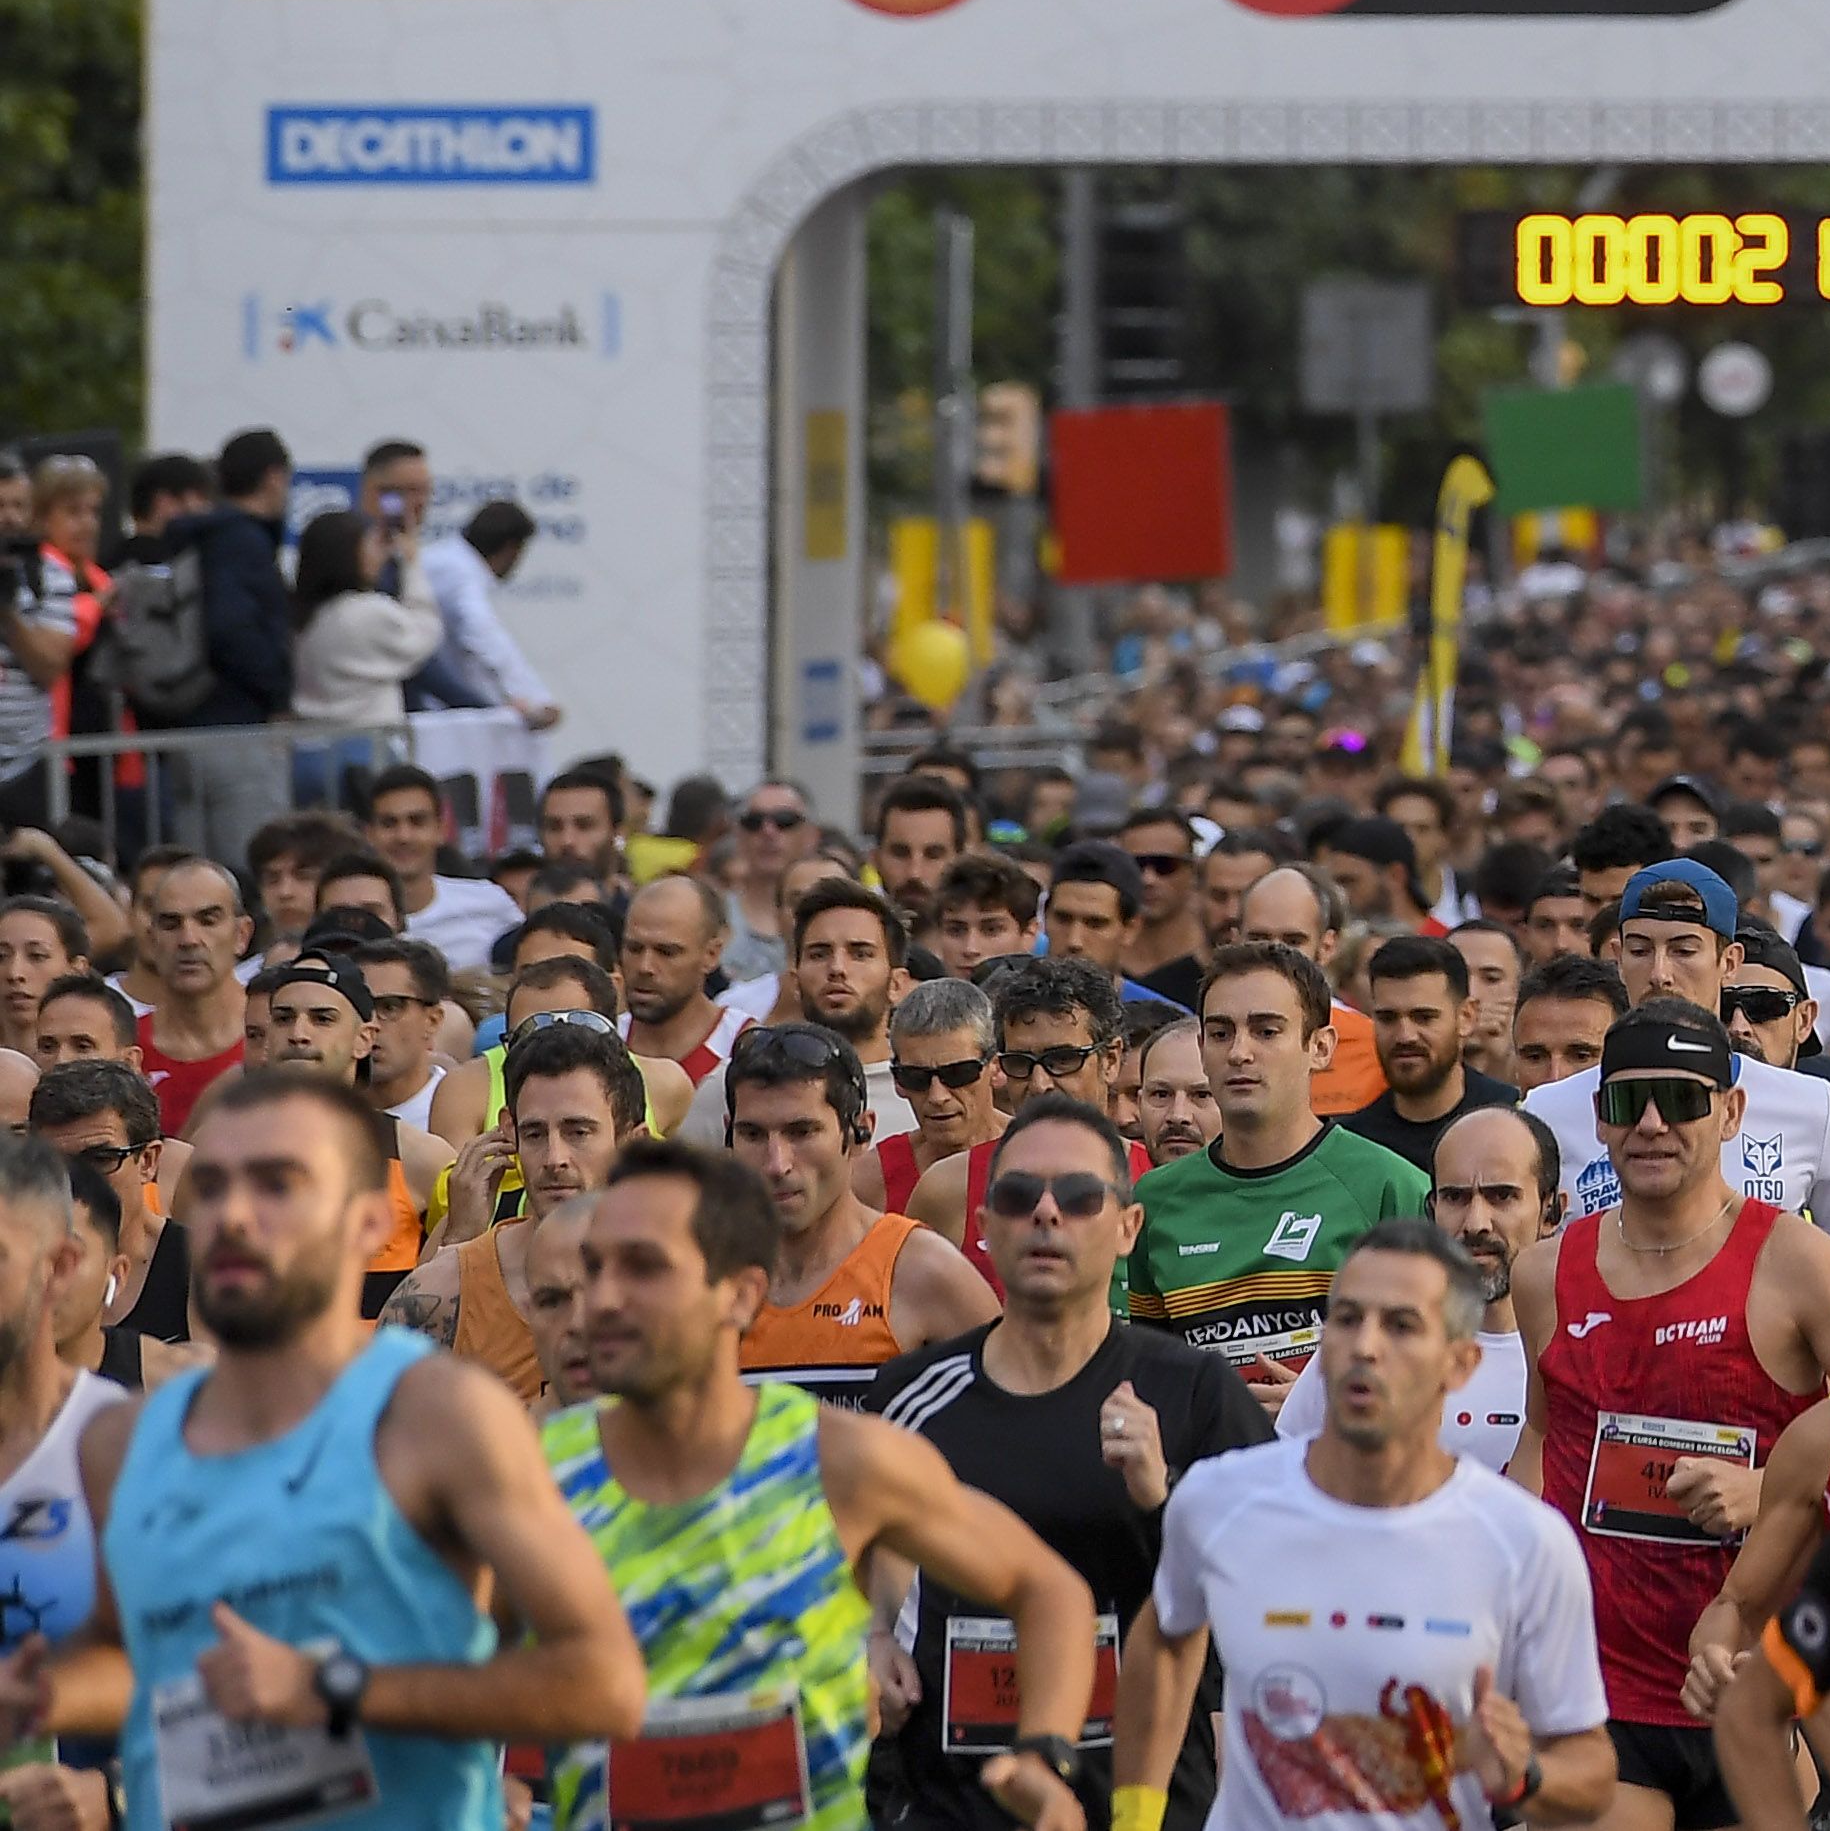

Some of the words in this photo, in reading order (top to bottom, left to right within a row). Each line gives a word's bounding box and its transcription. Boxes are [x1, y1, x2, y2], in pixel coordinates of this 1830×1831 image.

[281, 119, 580, 171] DECATHLON
[346, 297, 587, 352] CaixaBank
[813, 1304, 841, 1318] PRO
[862, 1305, 883, 1318] AM
[1655, 1316, 1727, 1346] BCTEAM
[1276, 1345, 1320, 1359] BARCELON
